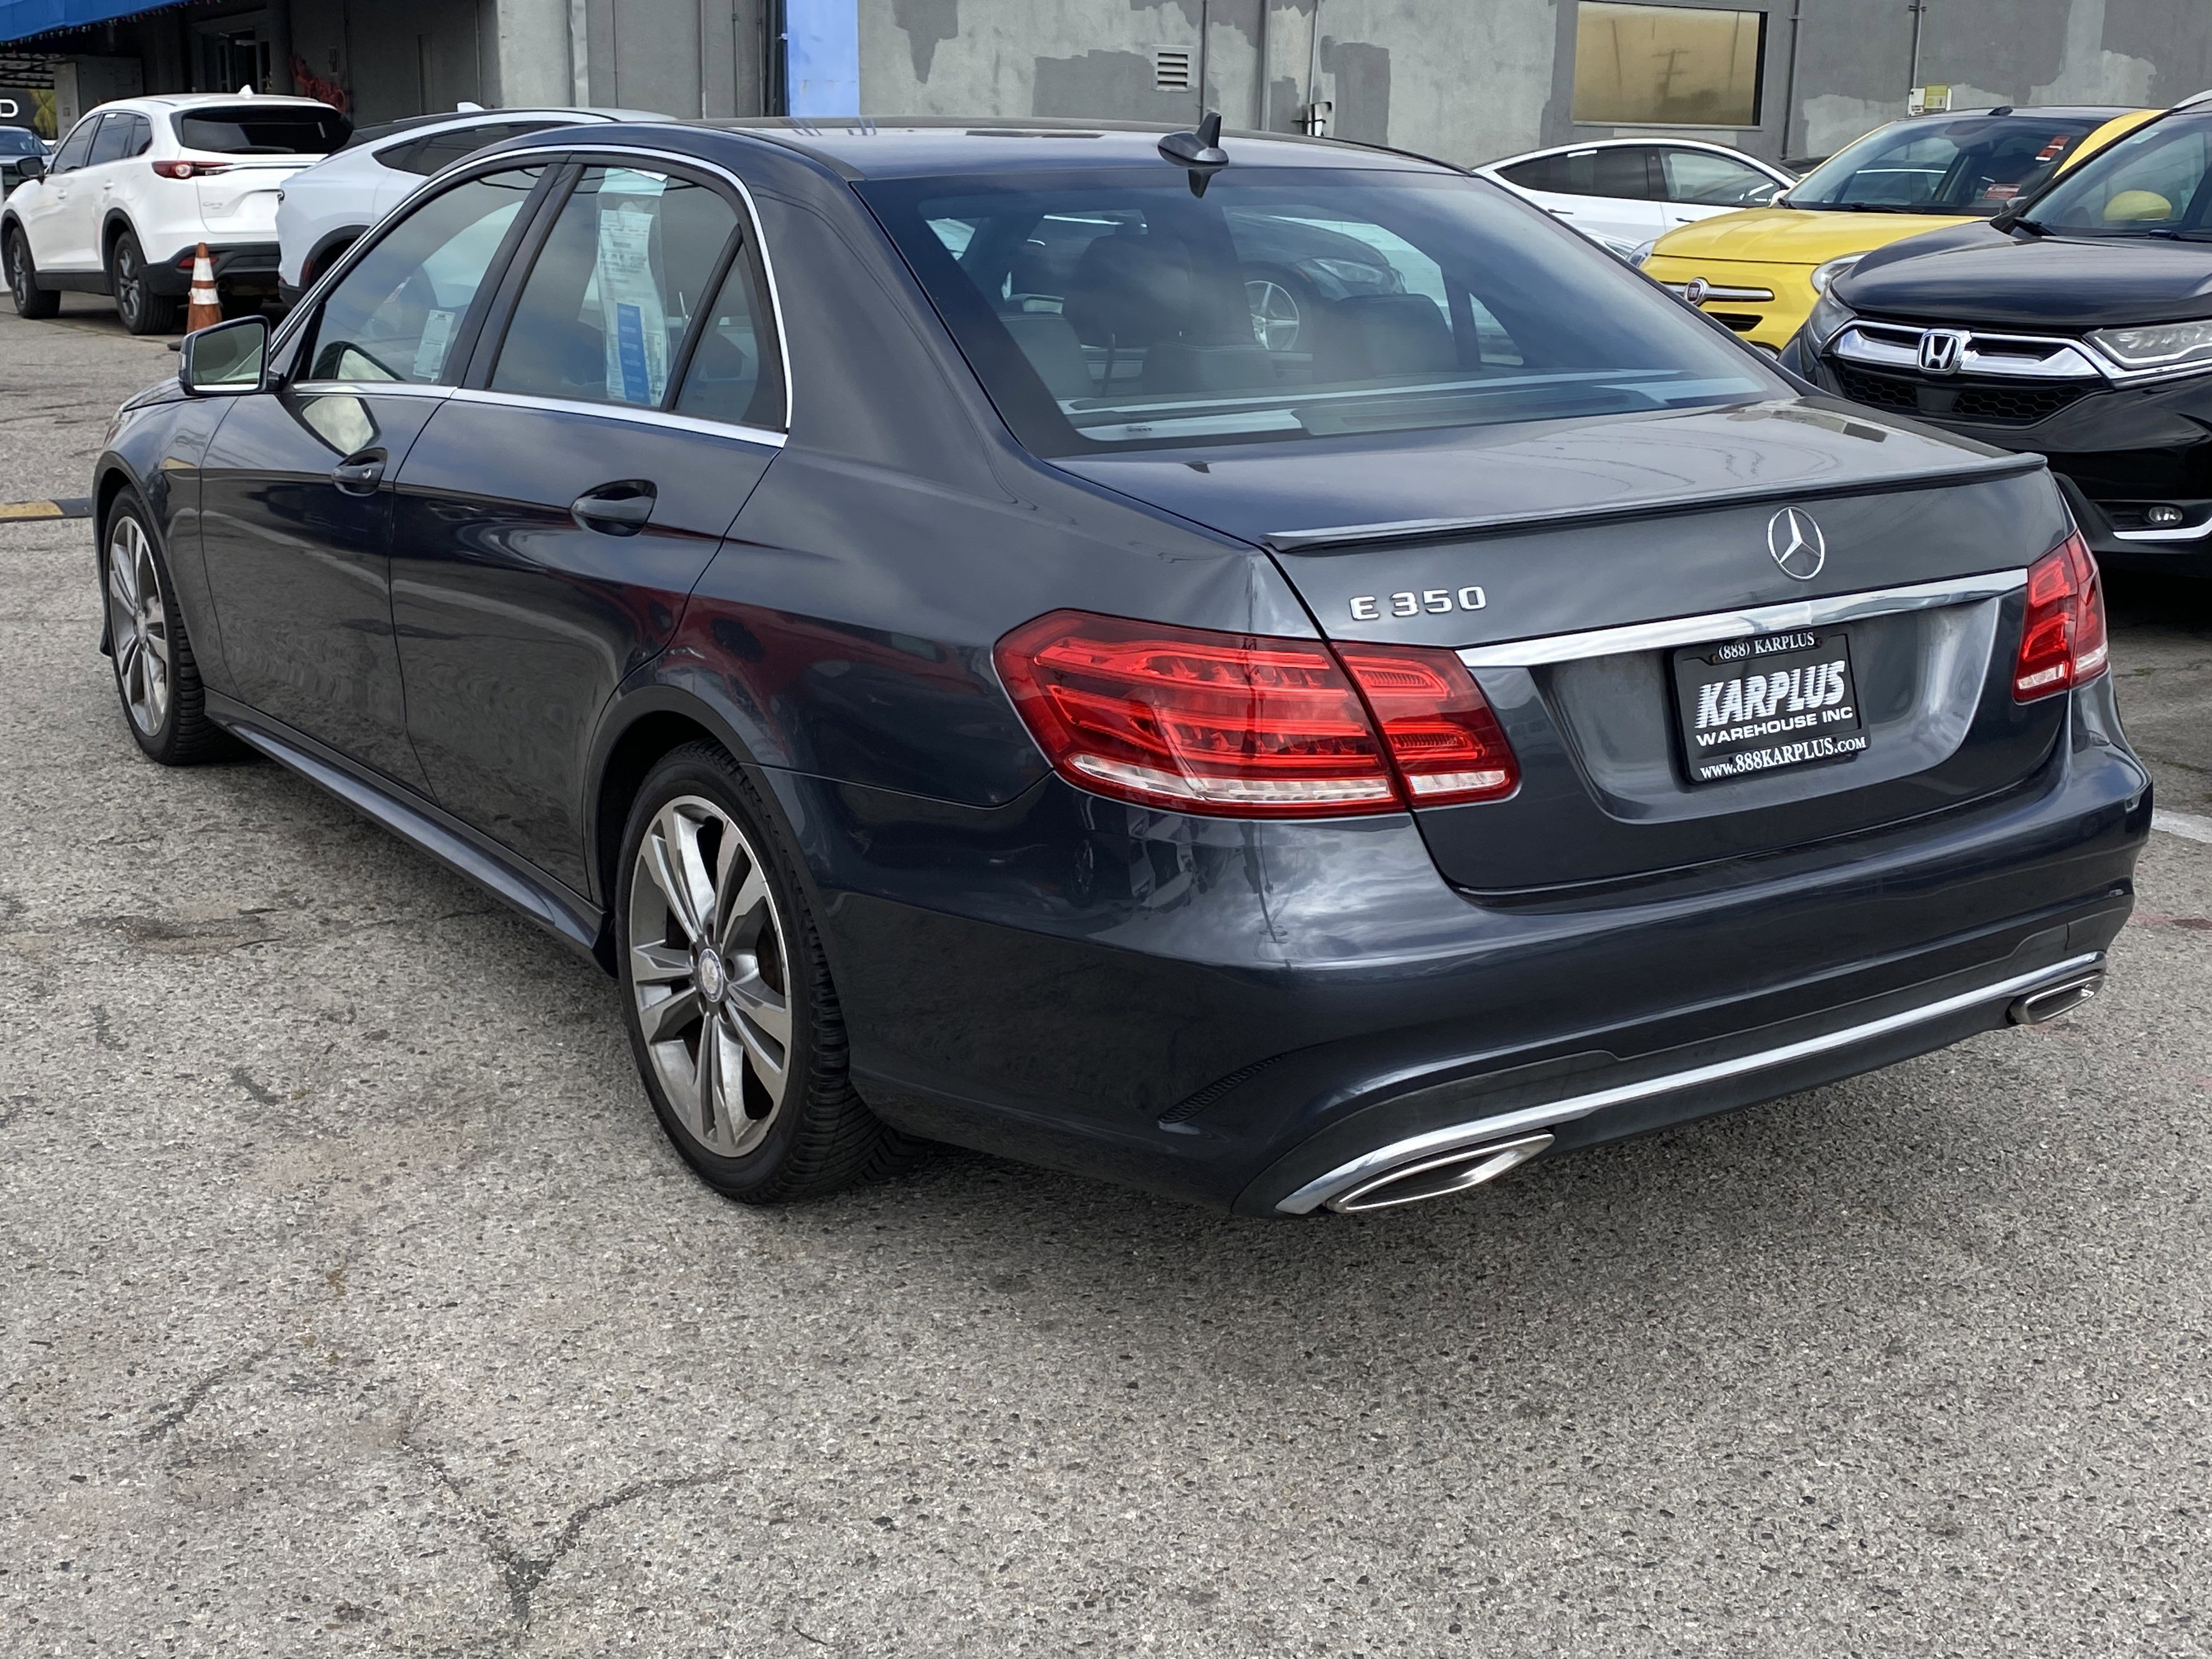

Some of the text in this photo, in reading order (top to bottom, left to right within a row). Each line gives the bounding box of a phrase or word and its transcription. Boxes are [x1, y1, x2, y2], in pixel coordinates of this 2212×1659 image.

[1350, 585, 1487, 620] E 350
[1718, 631, 1815, 661] (888) KARPLUS
[1694, 660, 1846, 729] KARPLUS
[1696, 706, 1854, 747] WAREHOUSE INC
